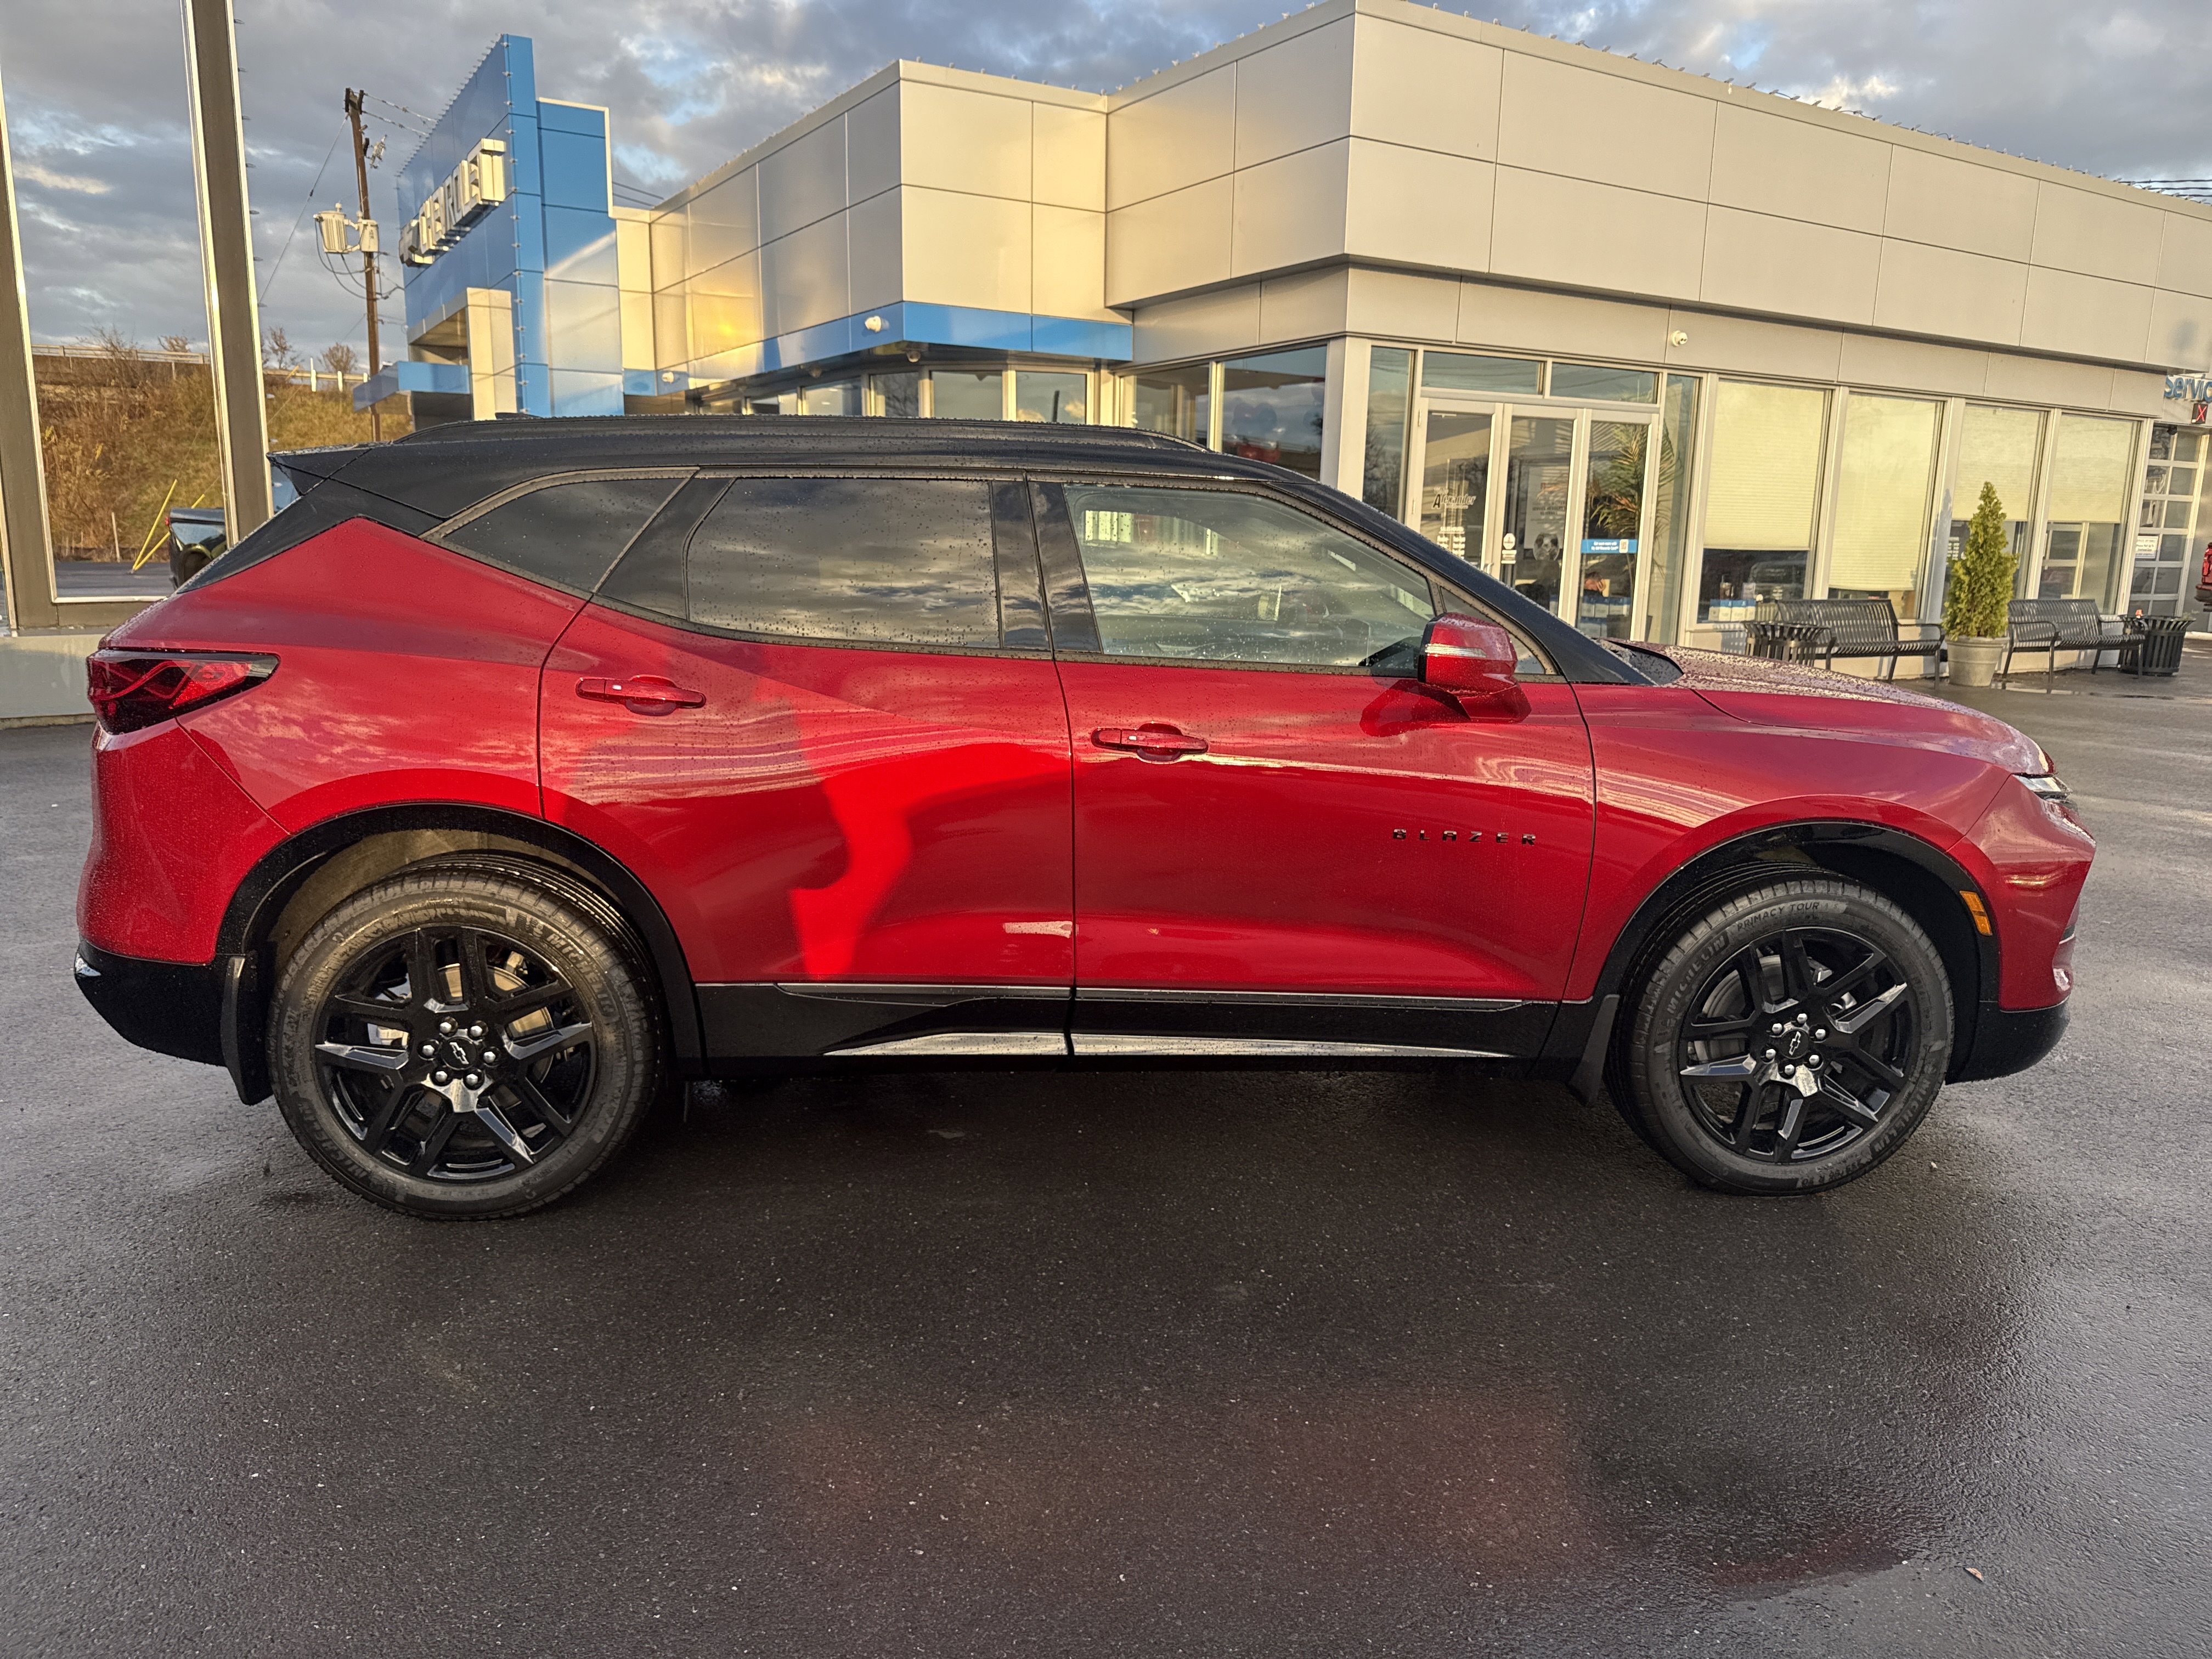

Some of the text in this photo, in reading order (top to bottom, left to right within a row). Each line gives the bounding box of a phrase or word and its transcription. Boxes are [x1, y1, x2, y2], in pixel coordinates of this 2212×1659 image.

[419, 138, 506, 255] CHEROLET
[1392, 828, 1536, 846] BLAZER
[546, 932, 619, 1023] MICHELIN
[1666, 934, 1727, 1014] MICHELIN
[1737, 906, 1785, 932] PRIMACY
[1790, 902, 1820, 912] TOUR
[1874, 1077, 1931, 1152] MICHELIN
